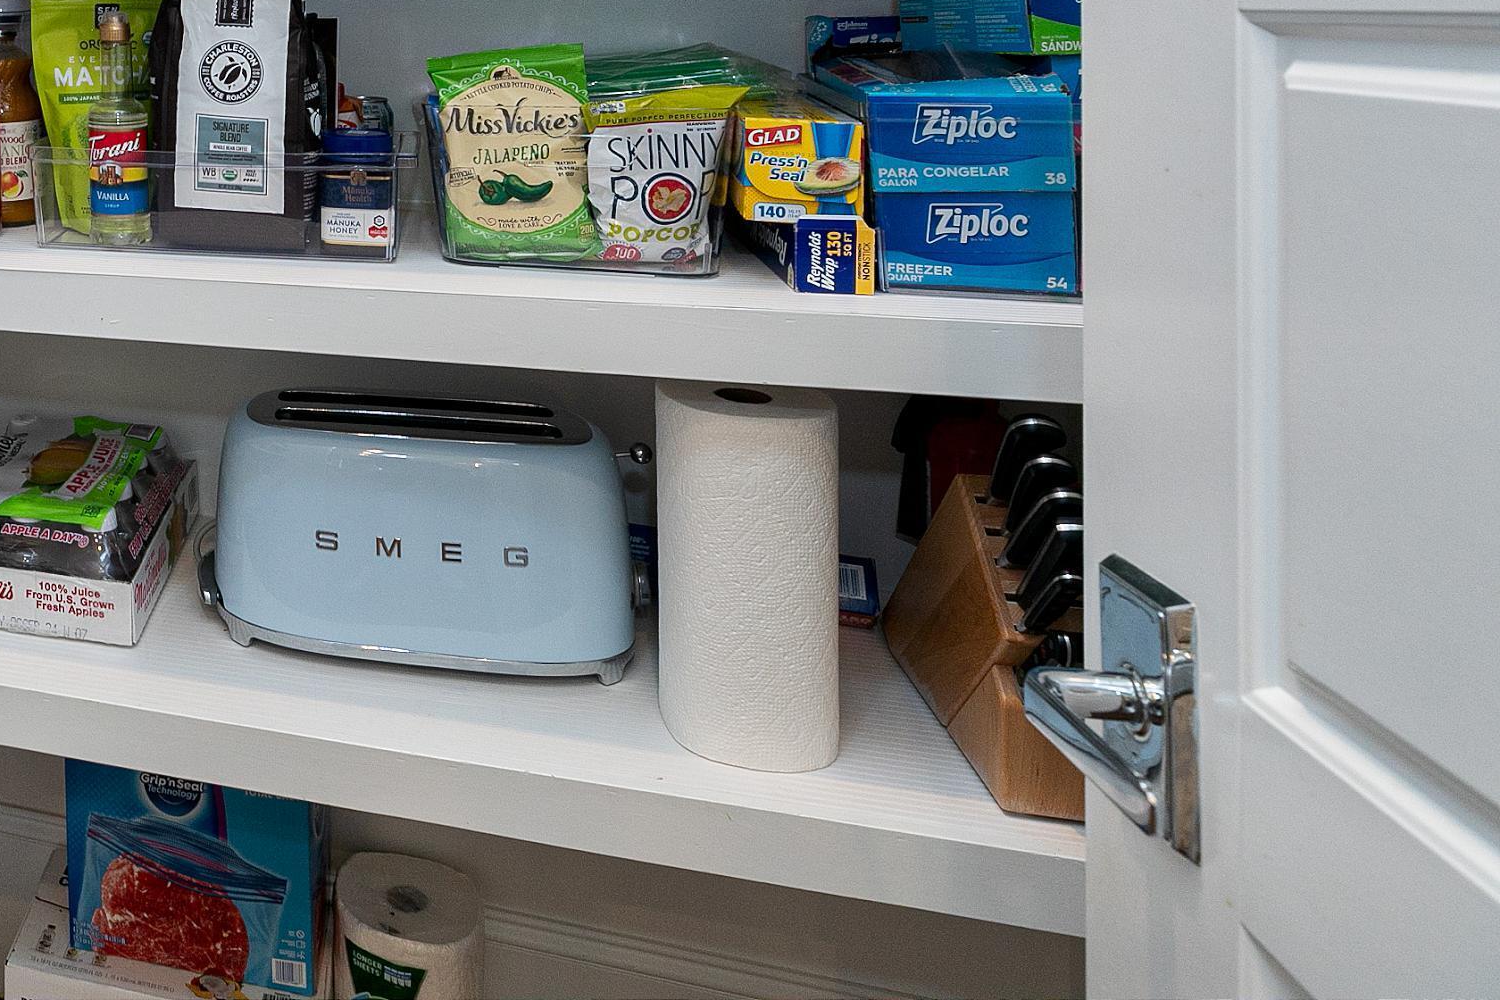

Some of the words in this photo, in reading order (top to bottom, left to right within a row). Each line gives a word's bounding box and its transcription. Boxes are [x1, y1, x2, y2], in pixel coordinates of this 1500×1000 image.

[205, 43, 258, 68] CHARLESTON
[226, 79, 259, 102] ROASTERS
[446, 104, 503, 136] Miss
[498, 97, 578, 138] Vickie's
[667, 112, 726, 121] PERFECTION
[920, 104, 1017, 144] Ziploc
[212, 121, 250, 134] SIGNATURE
[220, 132, 241, 143] BLEND
[748, 128, 800, 146] GLAD
[89, 132, 140, 167] Torani
[473, 143, 550, 164] JALAPEÑO
[607, 127, 721, 173] SKINNY
[750, 152, 808, 170] Press'n
[769, 167, 806, 183] Seal
[878, 168, 918, 180] PARA
[922, 167, 1009, 179] CONGELAR
[1044, 172, 1067, 185] 38
[97, 191, 129, 202] VANILLA
[758, 206, 786, 219] 140
[329, 226, 359, 235] HONEY
[934, 203, 1029, 243] Ziploc
[828, 232, 842, 256] 130
[807, 232, 822, 287] Reynolds
[862, 241, 871, 281] NONSTICK
[820, 257, 835, 291] Wrap
[887, 263, 953, 277] FREEZER
[887, 272, 924, 283] QUART
[1047, 277, 1068, 290] 54
[67, 457, 100, 495] APPLE
[96, 437, 116, 470] JUICE
[1, 523, 38, 536] APPLE
[315, 529, 529, 568] SMEG
[38, 581, 68, 592] 100%
[70, 585, 101, 598] Juice
[25, 589, 53, 601] From
[78, 597, 115, 610] Grown
[36, 601, 62, 613] Fresh
[64, 605, 105, 619] Apples
[147, 783, 198, 801] Technology
[352, 950, 383, 969] LONGER
[352, 959, 381, 978] SHEETS
